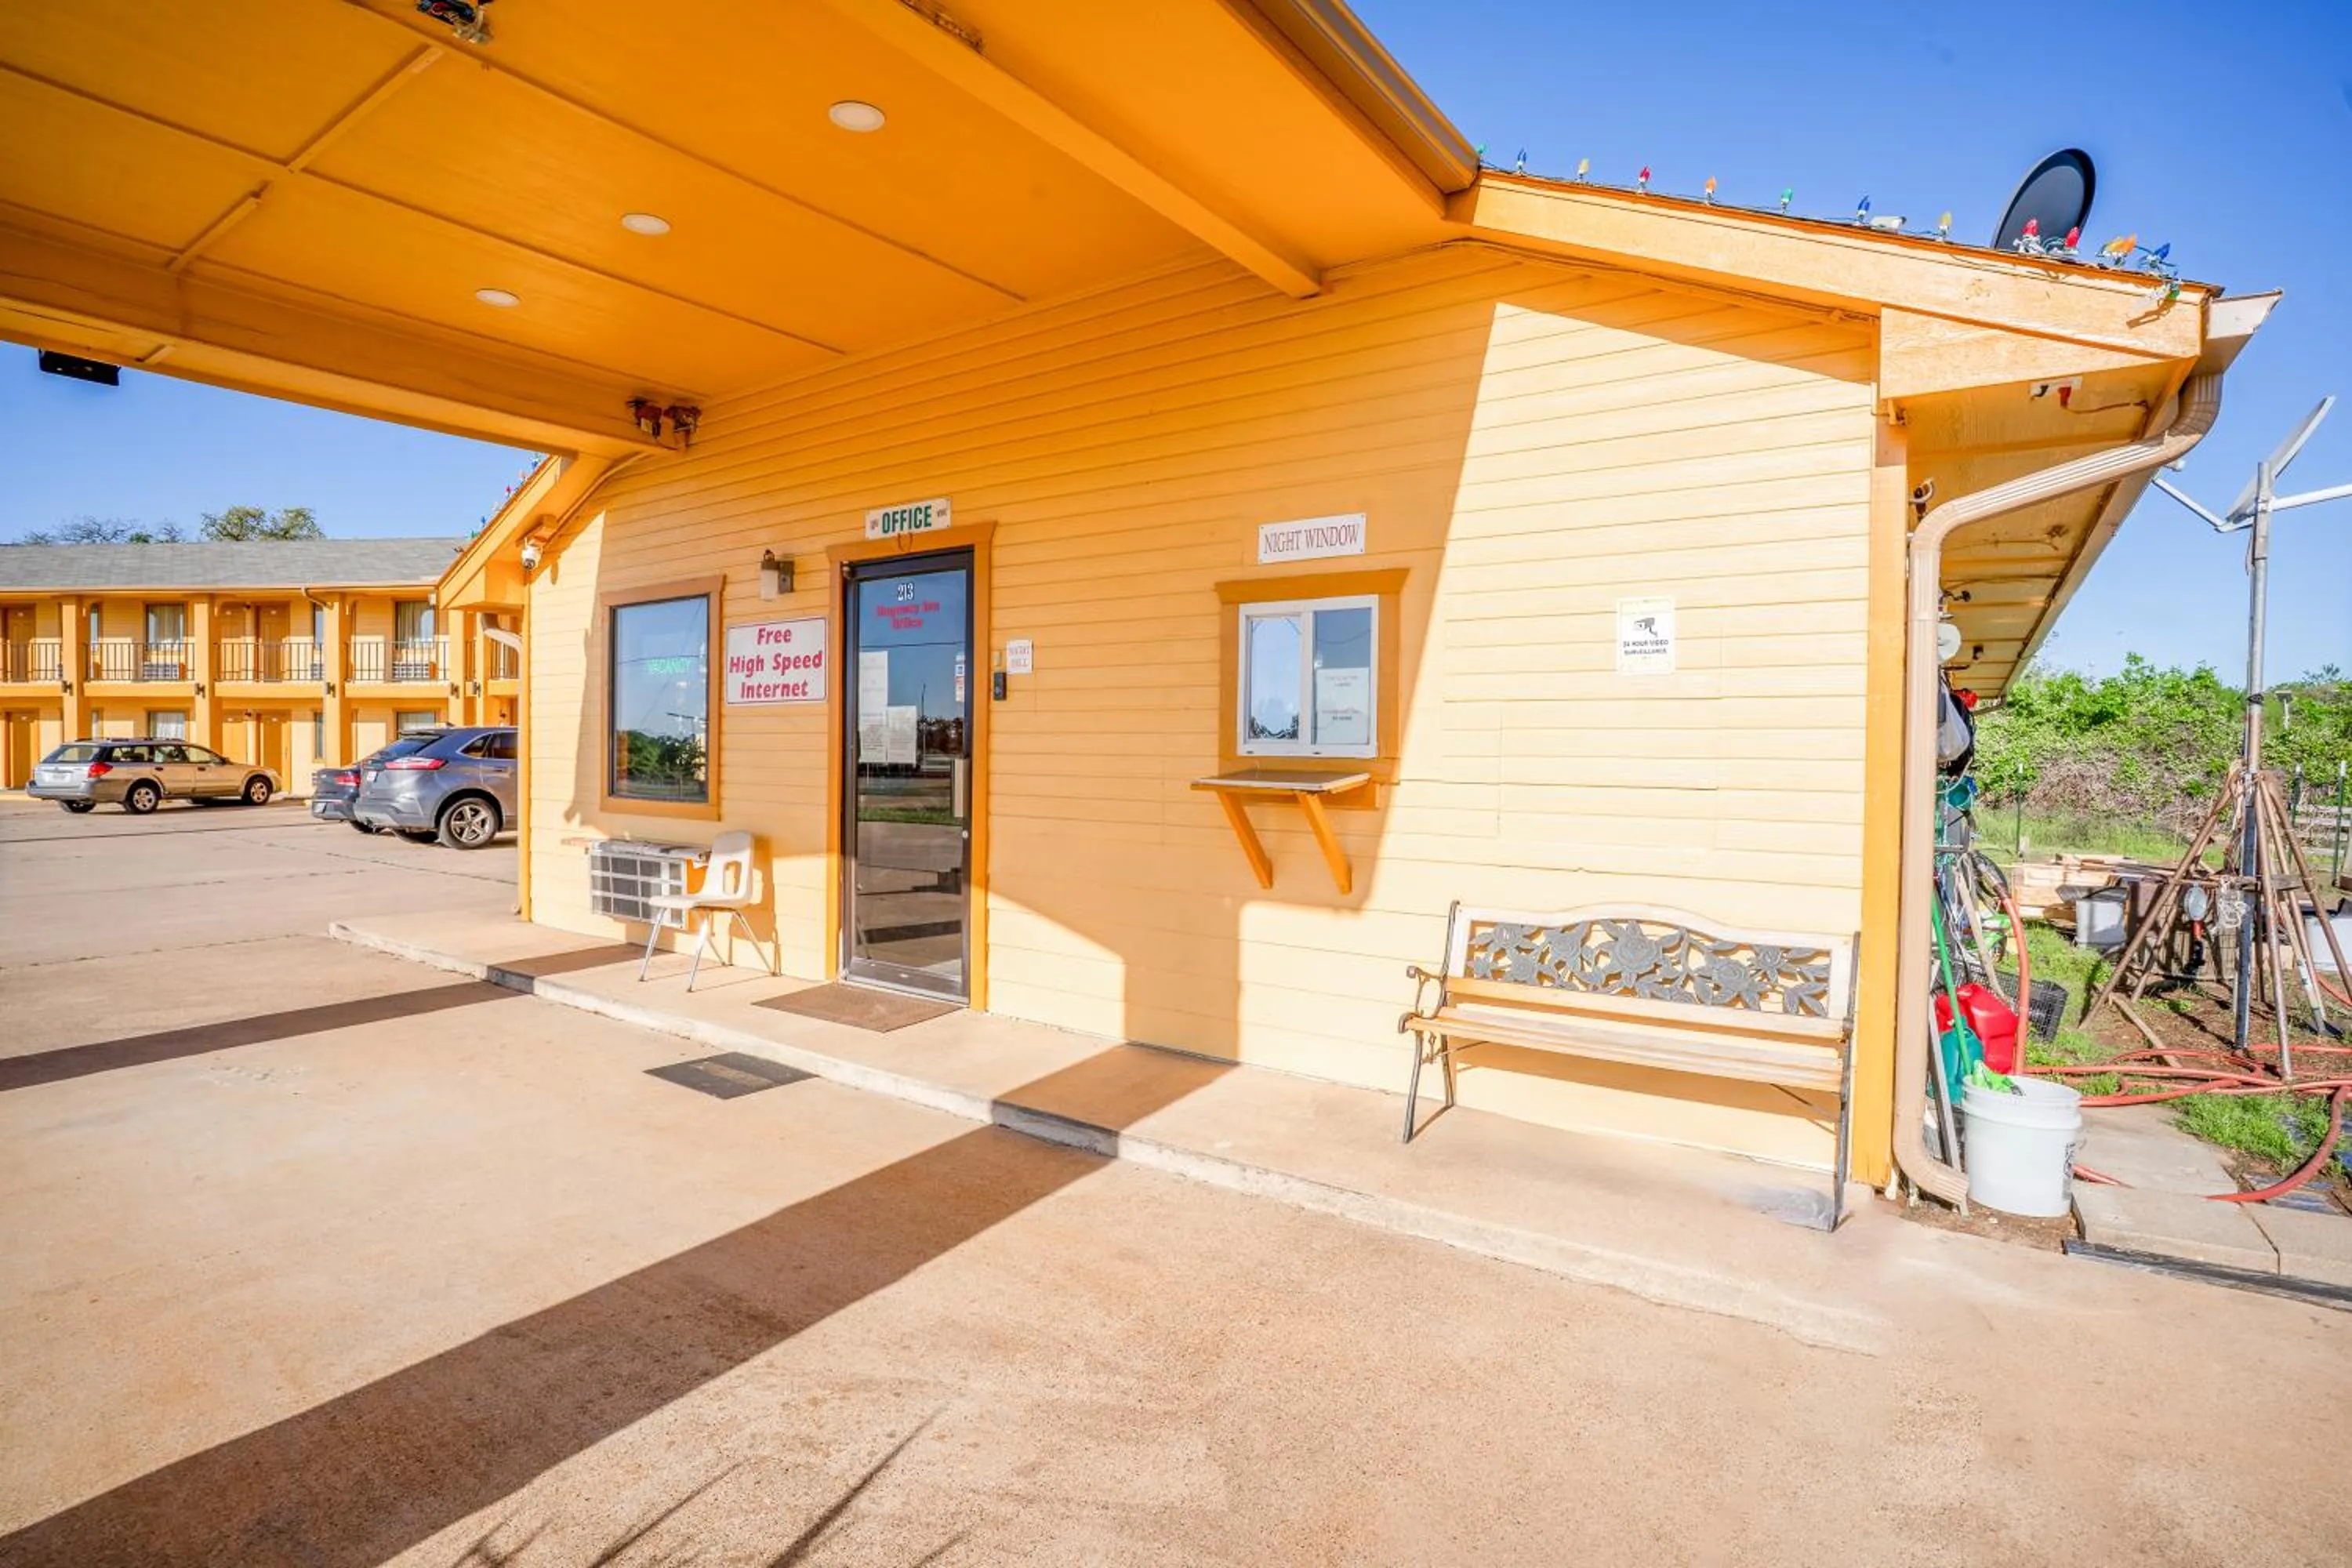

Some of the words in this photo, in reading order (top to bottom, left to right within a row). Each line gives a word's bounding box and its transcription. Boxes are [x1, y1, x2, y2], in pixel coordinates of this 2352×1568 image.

[882, 505, 931, 534] OFFICE
[1264, 530, 1302, 554] NIGHT
[1305, 523, 1360, 549] WINDOW
[897, 583, 914, 601] 213
[757, 627, 792, 645] Free
[729, 655, 764, 678] High
[772, 650, 822, 676] Speed
[740, 679, 808, 699] Internet
